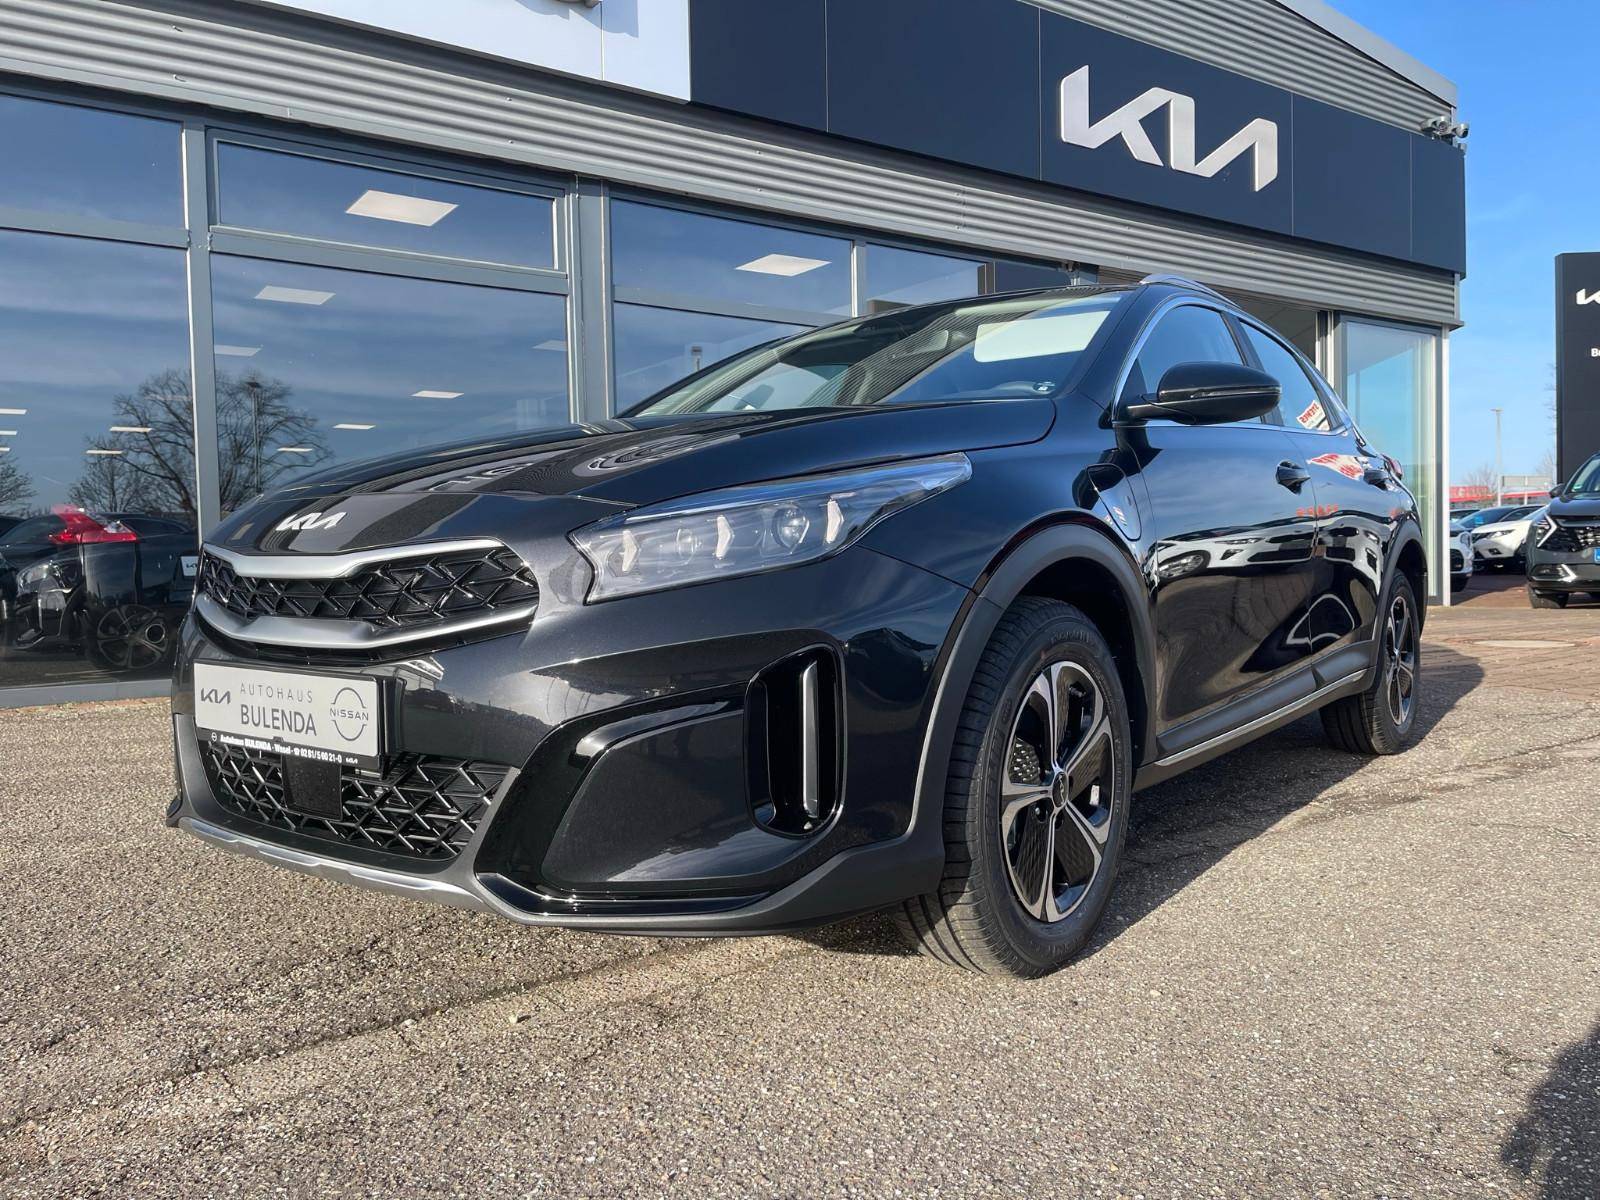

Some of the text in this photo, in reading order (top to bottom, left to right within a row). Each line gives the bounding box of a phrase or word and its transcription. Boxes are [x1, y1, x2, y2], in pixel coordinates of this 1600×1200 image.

[1060, 64, 1278, 192] KIA
[275, 511, 347, 531] KIA
[201, 687, 231, 705] KIA
[240, 682, 313, 704] AUTOHAUS
[241, 703, 317, 737] BULENDA
[329, 706, 369, 722] NISSAN
[244, 738, 272, 751] BULENDA
